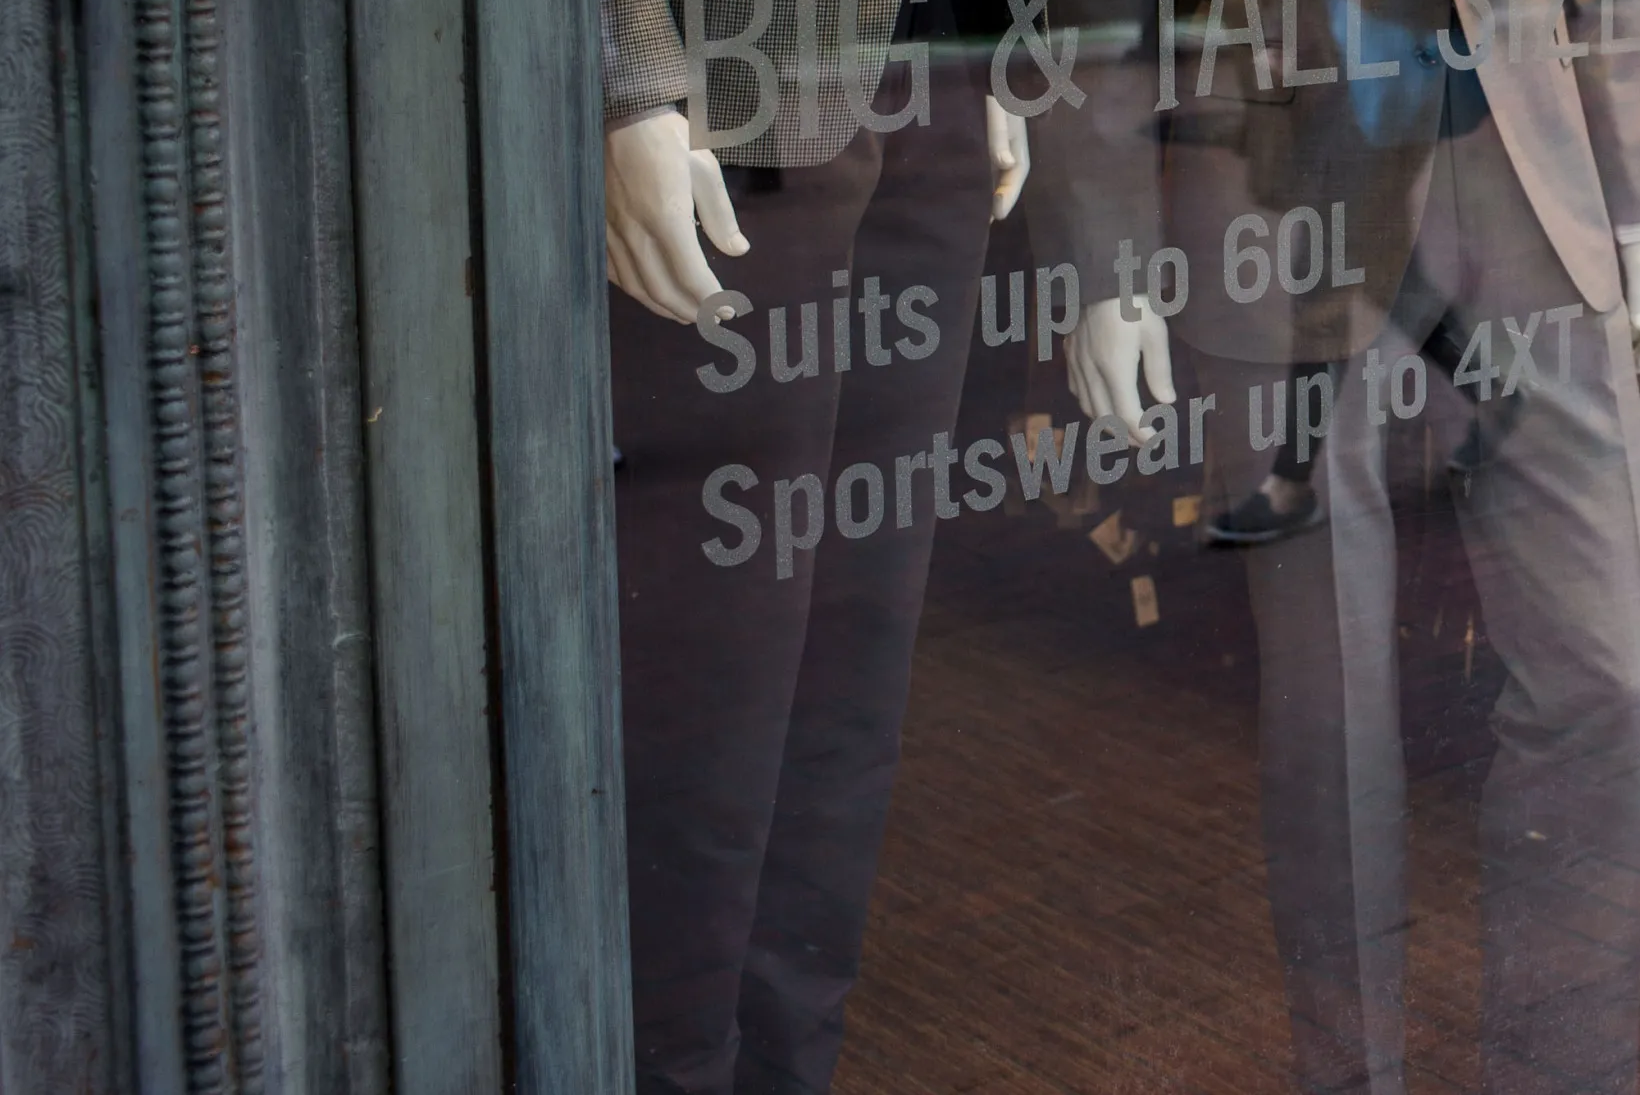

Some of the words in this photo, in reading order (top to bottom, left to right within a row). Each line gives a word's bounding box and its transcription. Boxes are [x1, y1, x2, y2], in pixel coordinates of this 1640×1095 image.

[696, 269, 941, 394] Suits
[980, 262, 1081, 362] up
[1113, 238, 1189, 323] to
[1223, 201, 1366, 304] 60L
[700, 392, 1217, 581] Sportswear
[1248, 369, 1335, 464] up
[1362, 347, 1428, 426] to
[1453, 302, 1584, 402] 4XT
